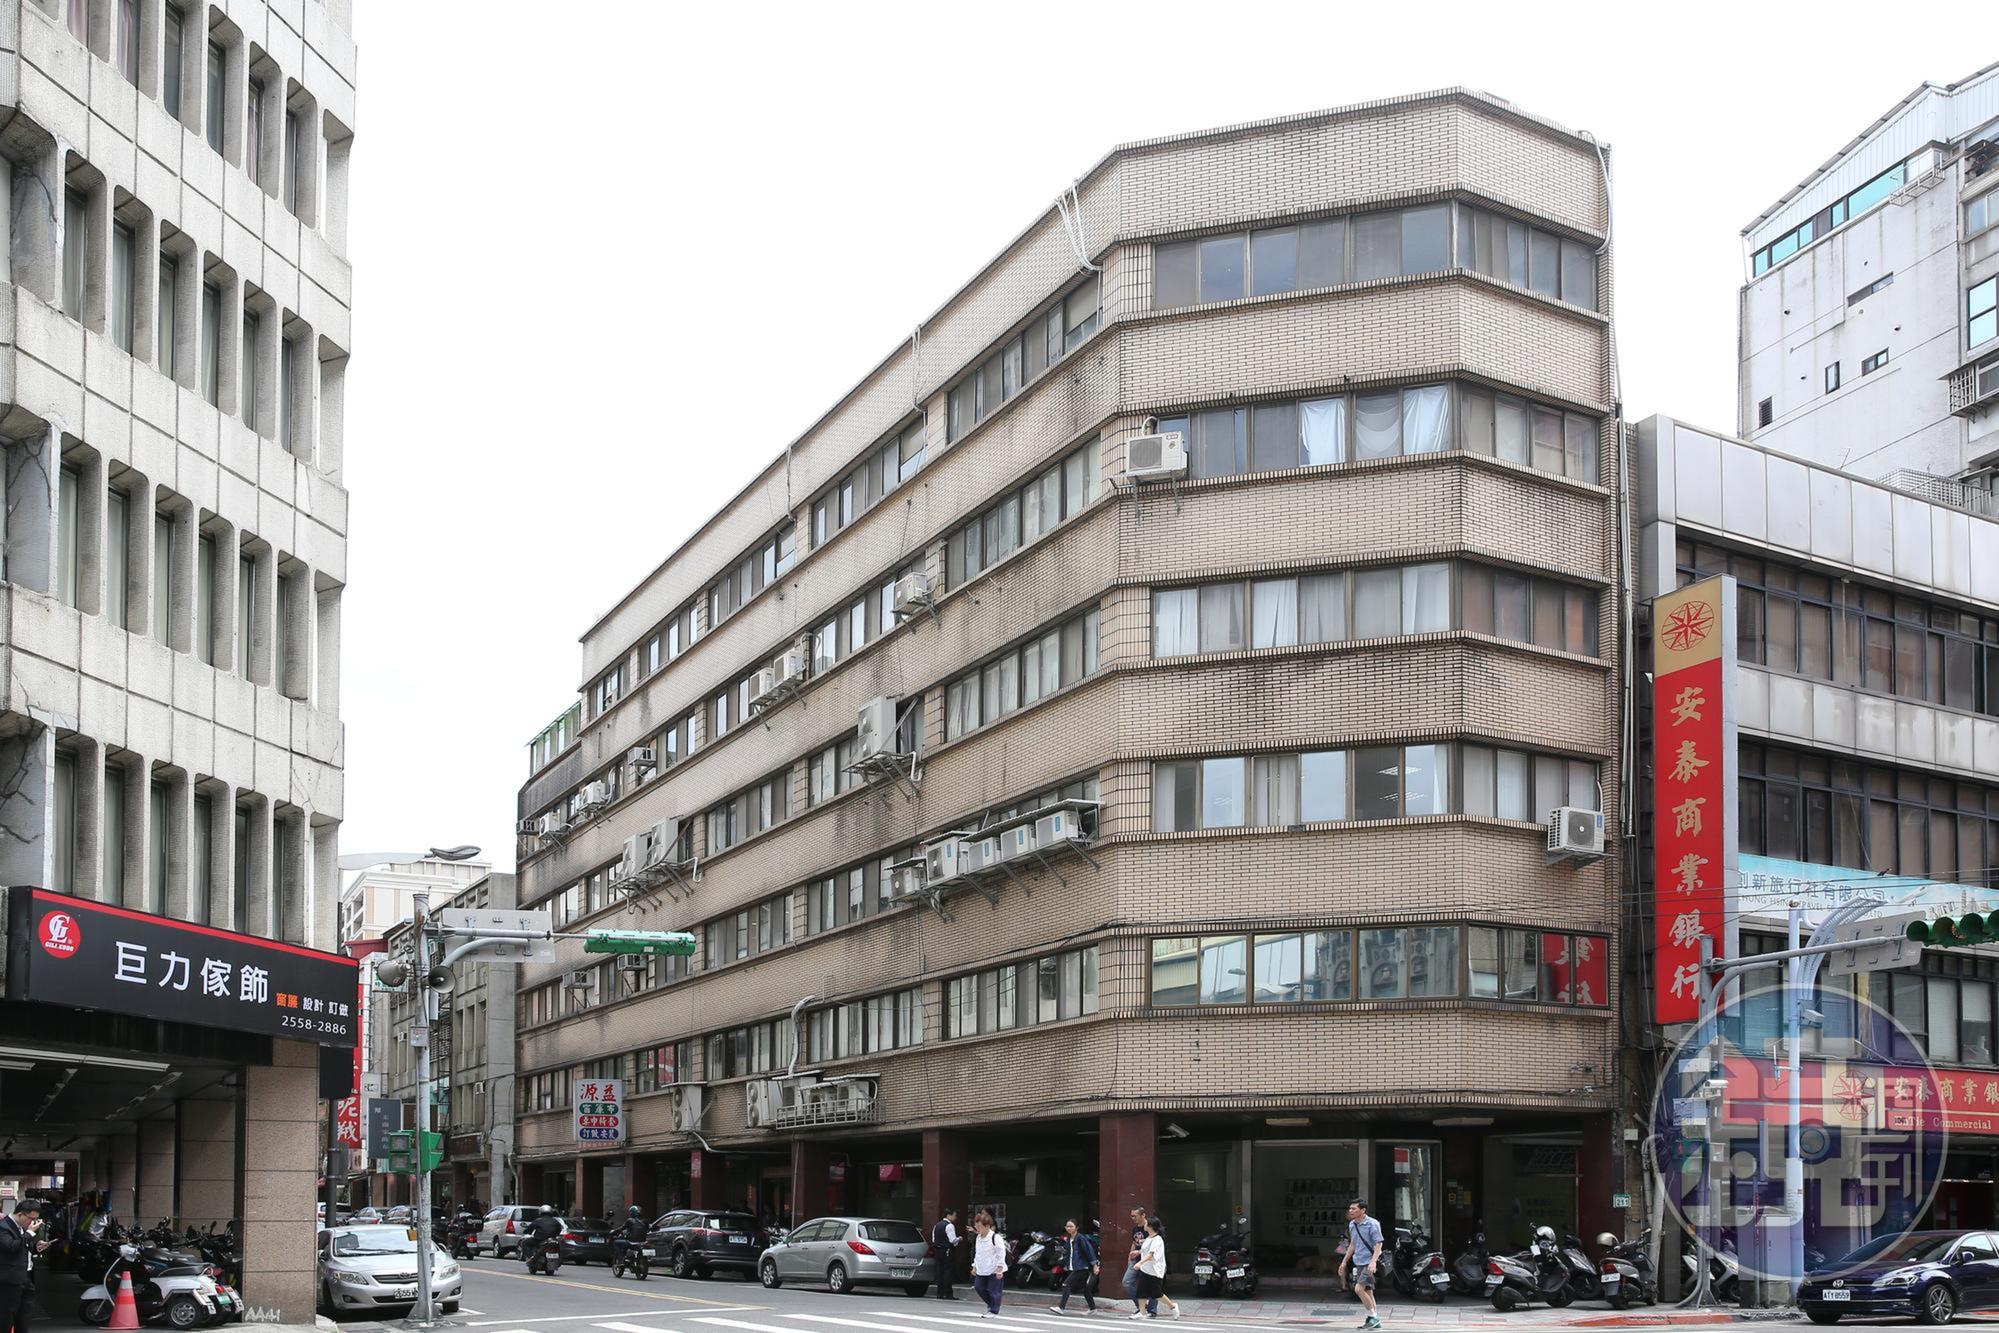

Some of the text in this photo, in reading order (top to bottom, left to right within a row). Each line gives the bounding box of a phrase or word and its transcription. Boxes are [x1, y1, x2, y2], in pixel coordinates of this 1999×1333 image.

[1668, 687, 1709, 1001] 安泰商業銀行
[114, 941, 269, 1004] 巨力傢飾
[303, 997, 324, 1013] 設計
[281, 1015, 347, 1035] 2558-2886
[580, 1083, 617, 1102] 源益
[1933, 1117, 1992, 1130] Commercial
